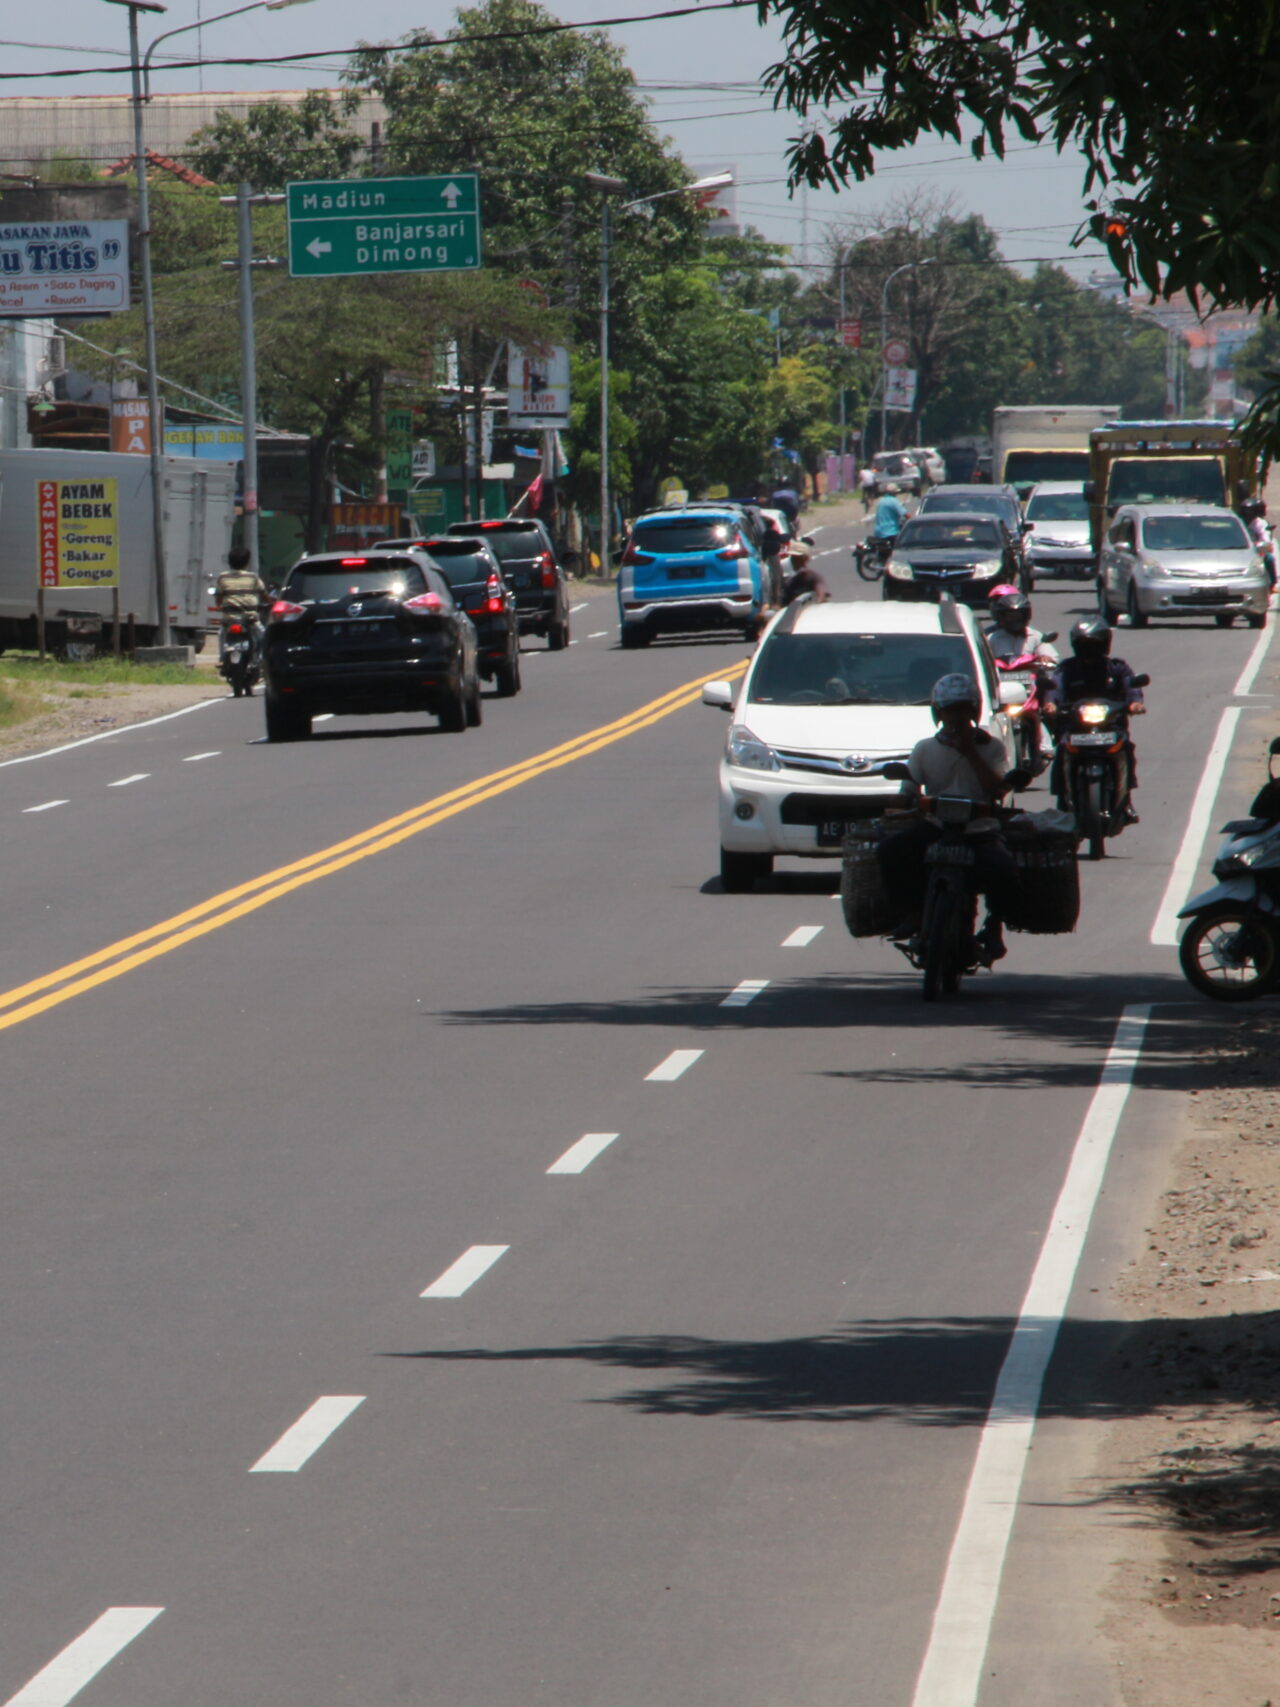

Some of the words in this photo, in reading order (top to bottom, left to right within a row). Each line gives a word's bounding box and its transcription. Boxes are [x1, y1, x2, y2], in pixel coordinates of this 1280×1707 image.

[303, 191, 385, 209] Madiun
[54, 225, 90, 239] JAWA
[355, 220, 465, 243] Banjarsari
[27, 243, 97, 271] Titis
[357, 246, 448, 263] Dimong
[50, 279, 76, 290] Soto
[80, 279, 116, 291] Daging
[127, 419, 146, 451] PA
[61, 484, 105, 499] AYAM
[61, 503, 113, 519] BEBEK
[66, 550, 106, 561] Bakar
